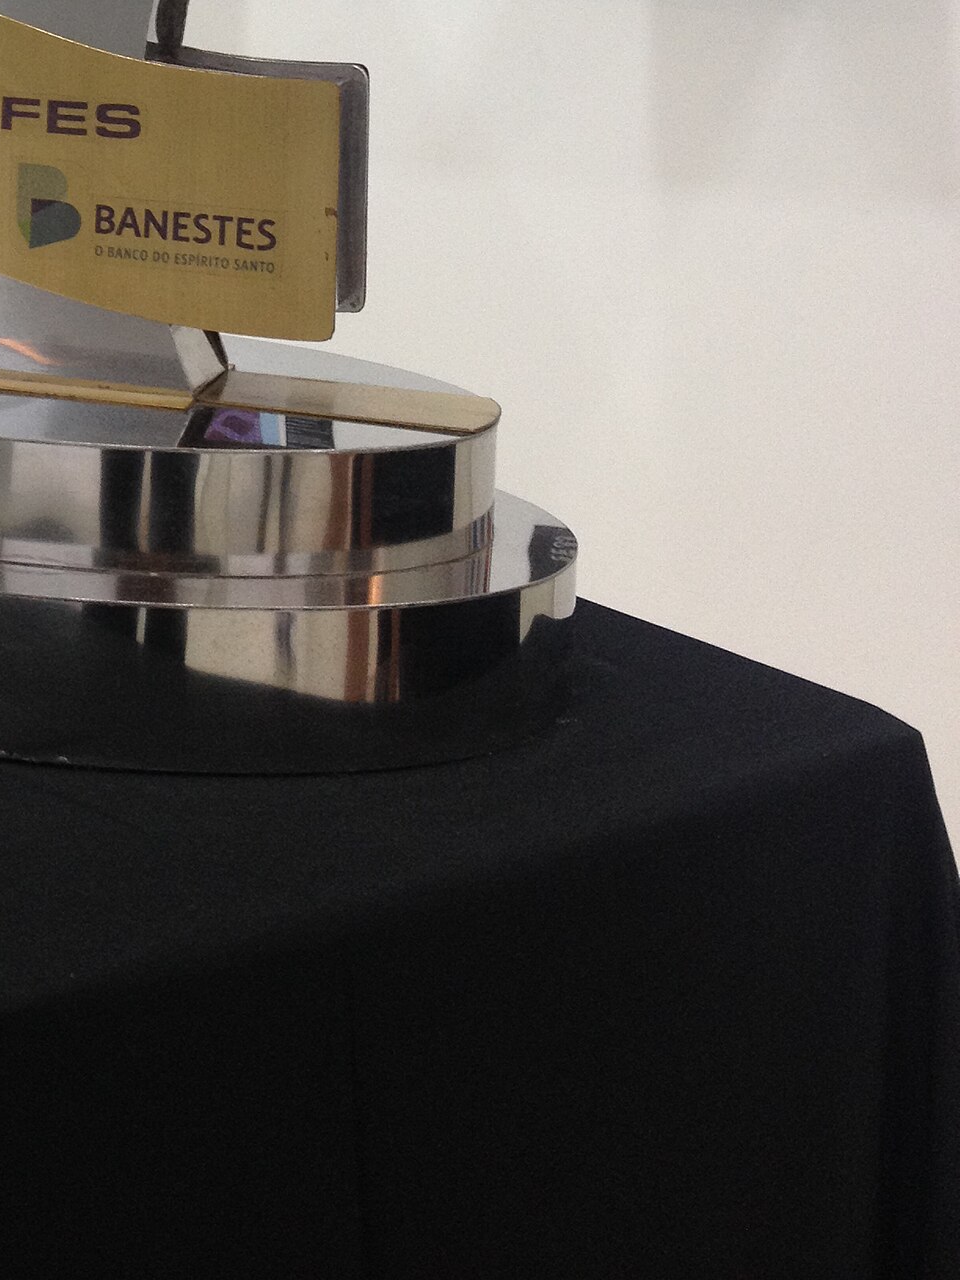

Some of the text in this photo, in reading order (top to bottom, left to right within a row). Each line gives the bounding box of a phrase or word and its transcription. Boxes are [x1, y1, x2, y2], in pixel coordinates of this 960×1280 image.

[0, 96, 142, 139] FES
[94, 204, 278, 251] BANESTES
[94, 245, 275, 274] O BANCO DO ESPÍRITO SANTO
